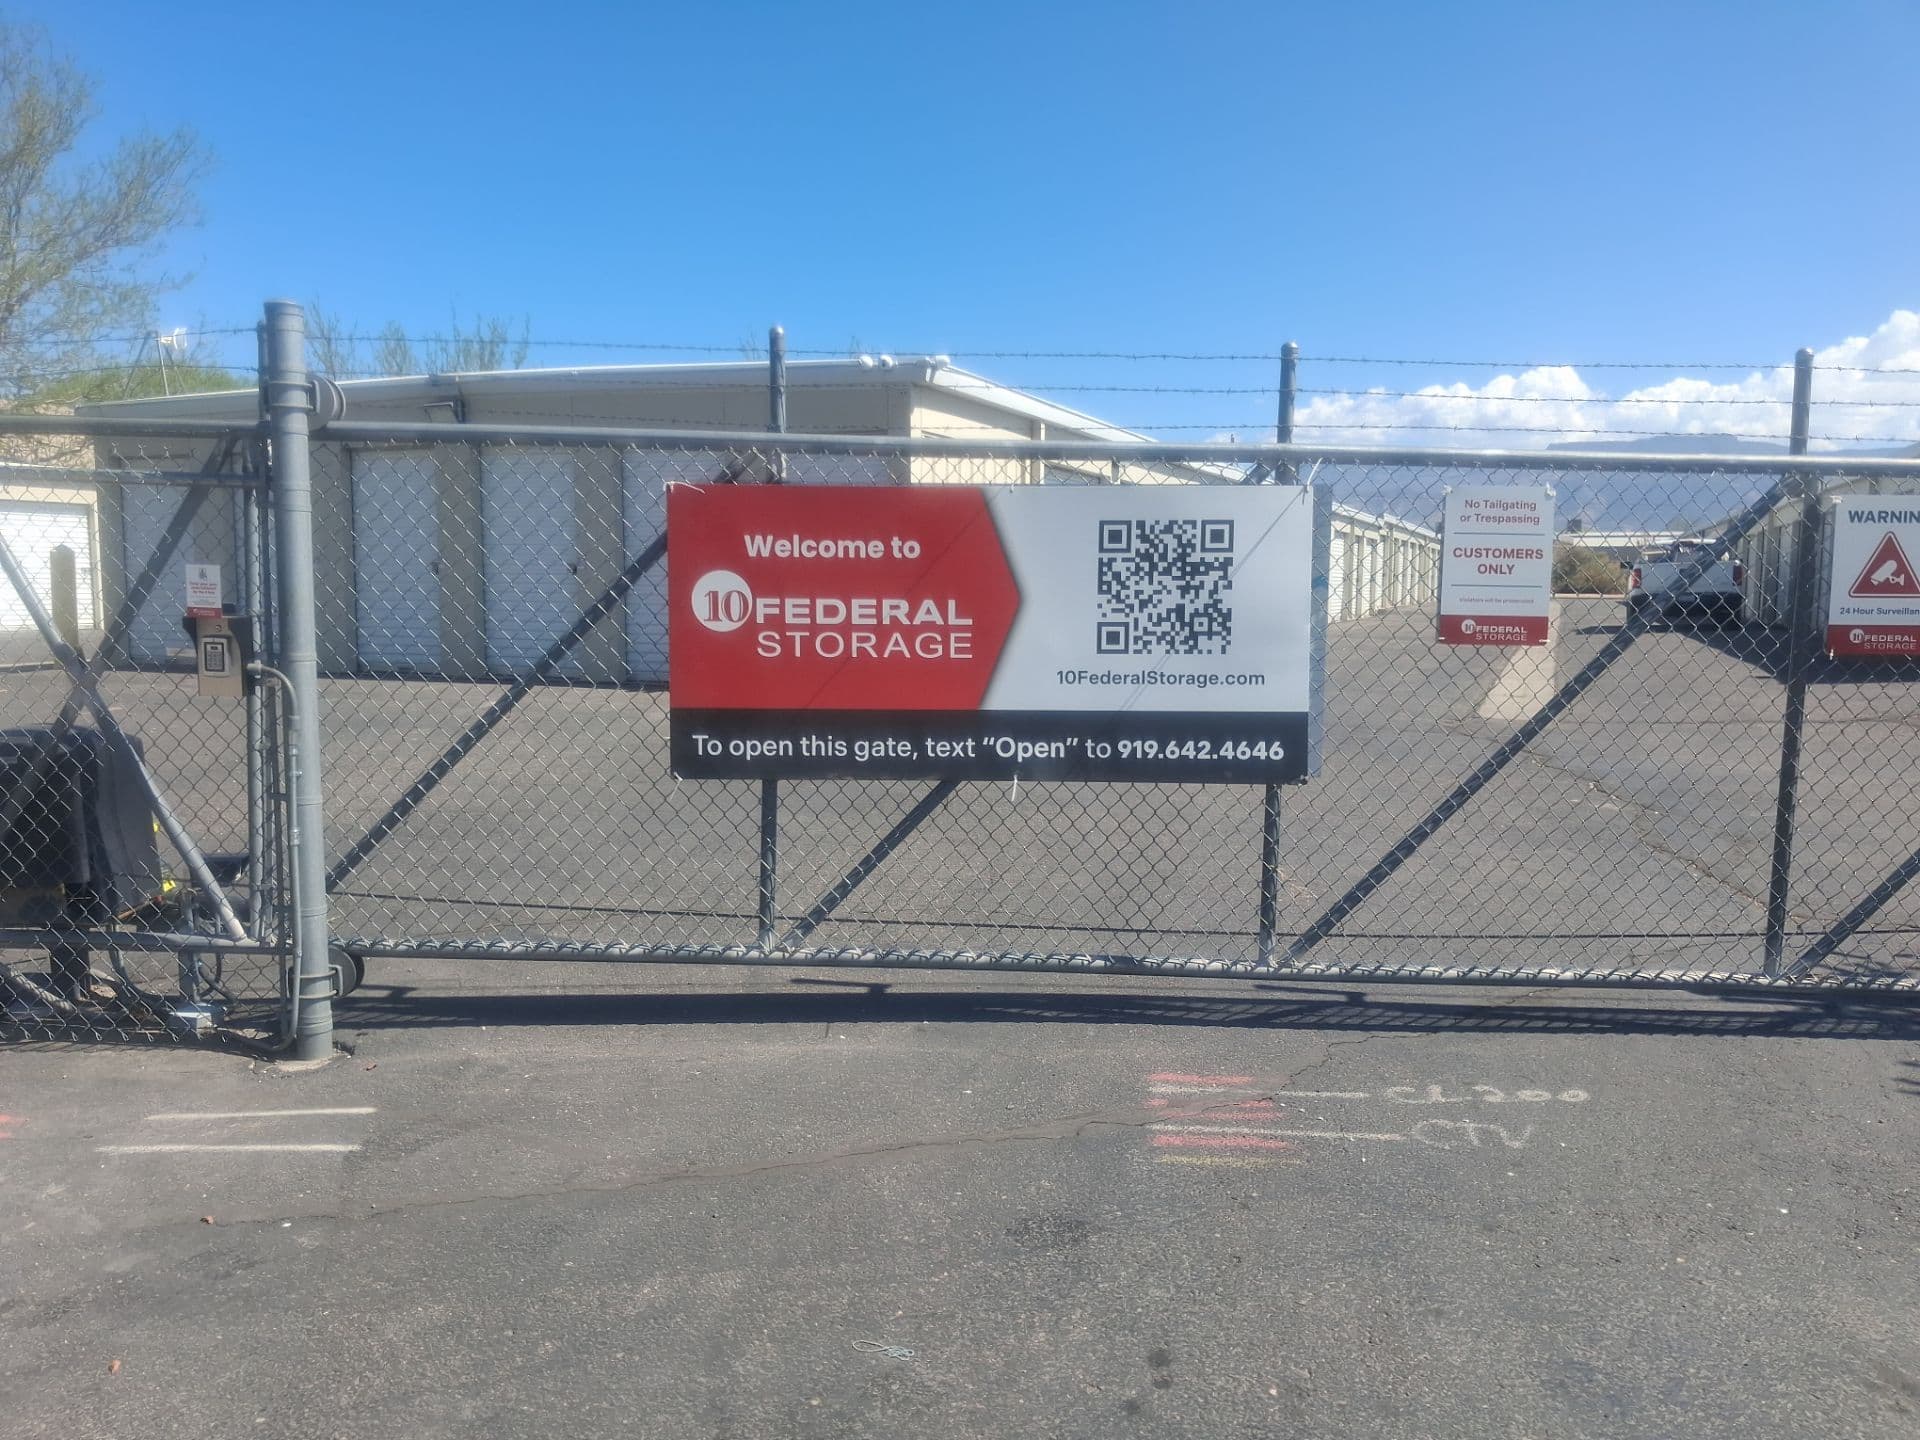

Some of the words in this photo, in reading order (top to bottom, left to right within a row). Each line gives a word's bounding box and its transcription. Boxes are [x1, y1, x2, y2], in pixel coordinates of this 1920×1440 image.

[1464, 499, 1480, 510] No
[1483, 499, 1537, 512] Tailgating
[1460, 514, 1472, 522] or
[1475, 513, 1541, 525] Trespassing
[1848, 510, 1920, 523] WARNIN
[743, 534, 885, 559] Welcome
[891, 536, 921, 559] to
[1452, 547, 1544, 560] CUSTOMERS
[1477, 563, 1516, 575] ONLY
[703, 589, 750, 623] 10
[755, 597, 973, 626] FEDERAL
[1840, 607, 1851, 615] 24
[1852, 607, 1875, 615] Hour
[1475, 625, 1528, 634] FEDERAL
[1475, 633, 1528, 642] STORAGE
[1864, 634, 1917, 642] FEDERAL
[756, 630, 974, 659] STORAGE
[1864, 642, 1917, 650] STORAGE
[1056, 669, 1266, 688] 10FederalStorage.com
[691, 734, 723, 757] To
[729, 736, 794, 761] open
[800, 734, 847, 757] this
[854, 737, 918, 762] gate,
[925, 737, 976, 758] text
[982, 735, 1079, 763] “Open”
[1085, 738, 1112, 759] to
[1117, 739, 1285, 761] 919.642.4646
